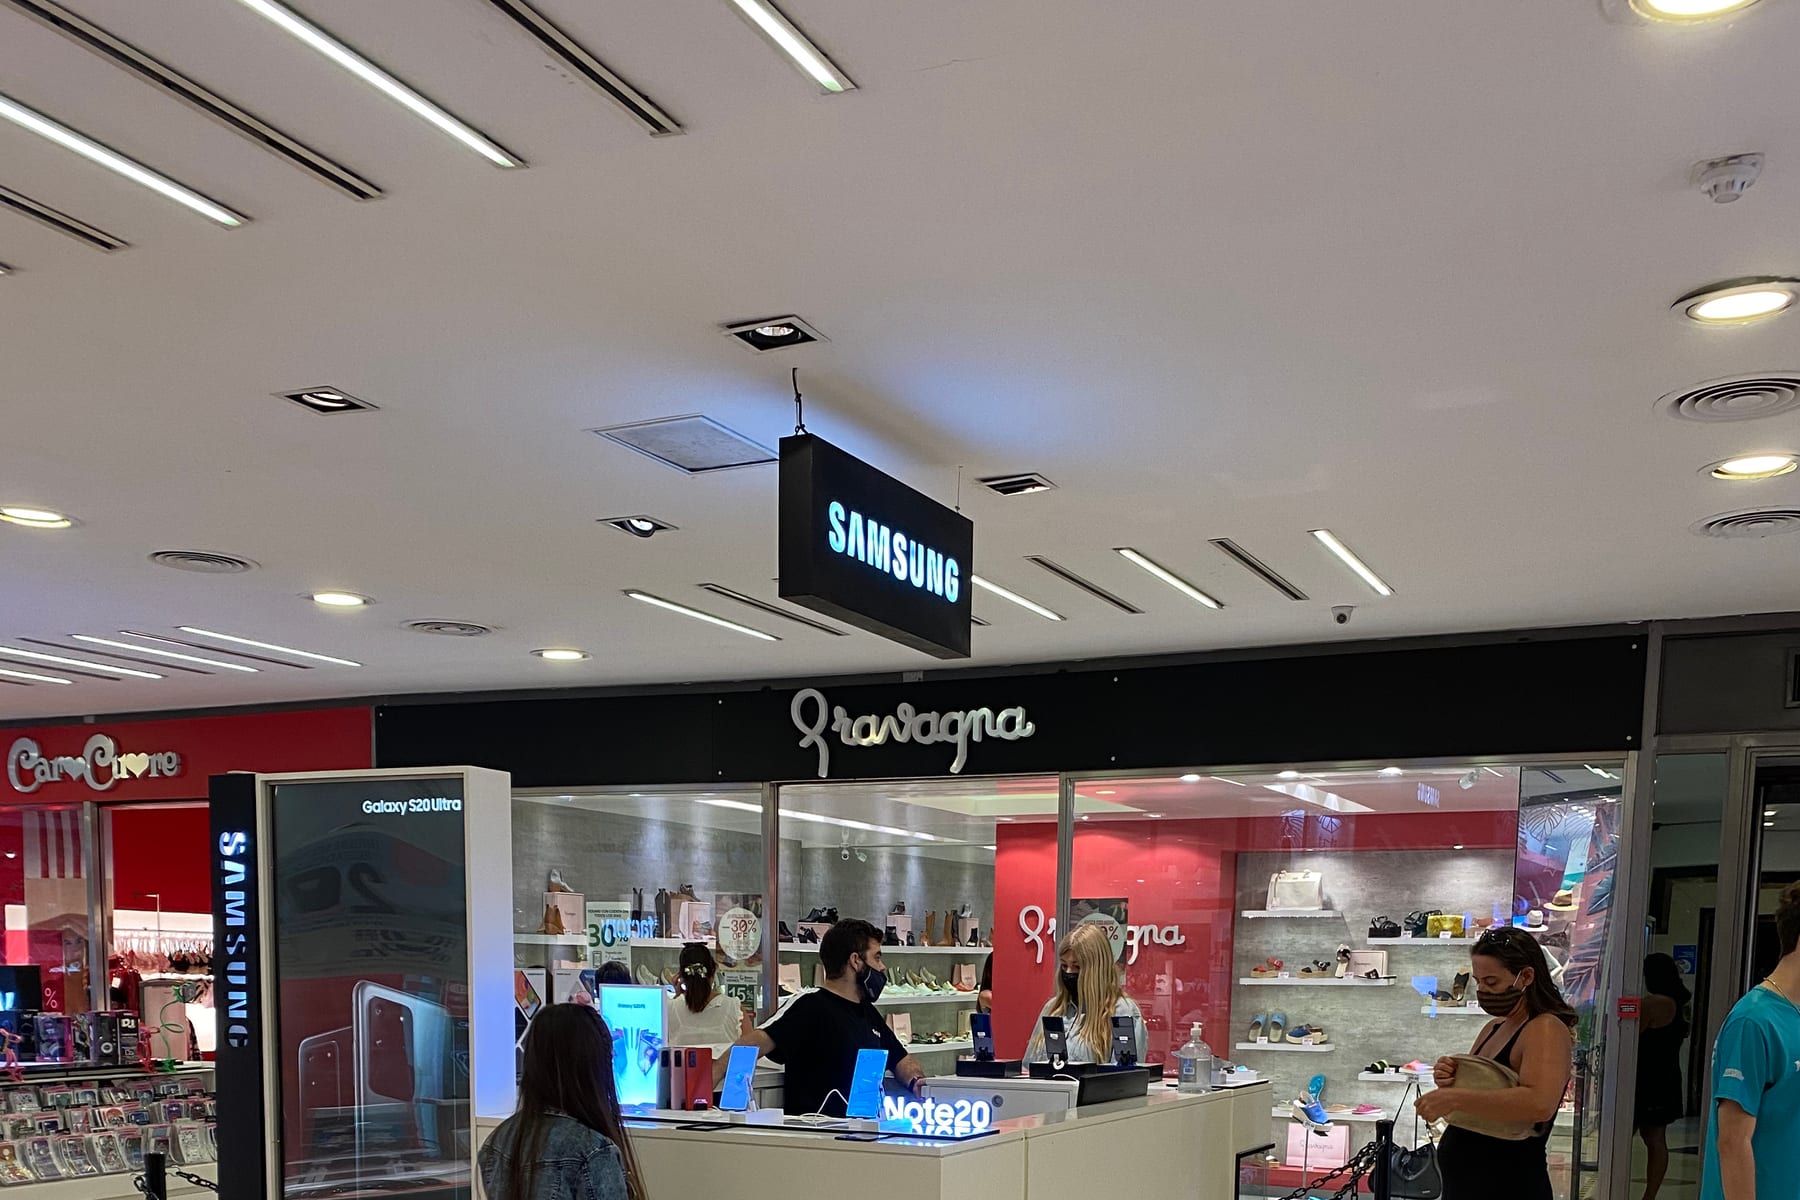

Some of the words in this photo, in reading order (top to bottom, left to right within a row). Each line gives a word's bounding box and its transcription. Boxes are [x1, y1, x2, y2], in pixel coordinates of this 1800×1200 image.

[828, 501, 960, 604] SAMSUNG
[790, 688, 1036, 778] Gravagna
[362, 800, 408, 816] Galaxy
[408, 798, 431, 812] S20
[431, 797, 462, 811] Ultra
[219, 831, 249, 1048] SAMSUNG
[883, 1095, 992, 1130] Note20
